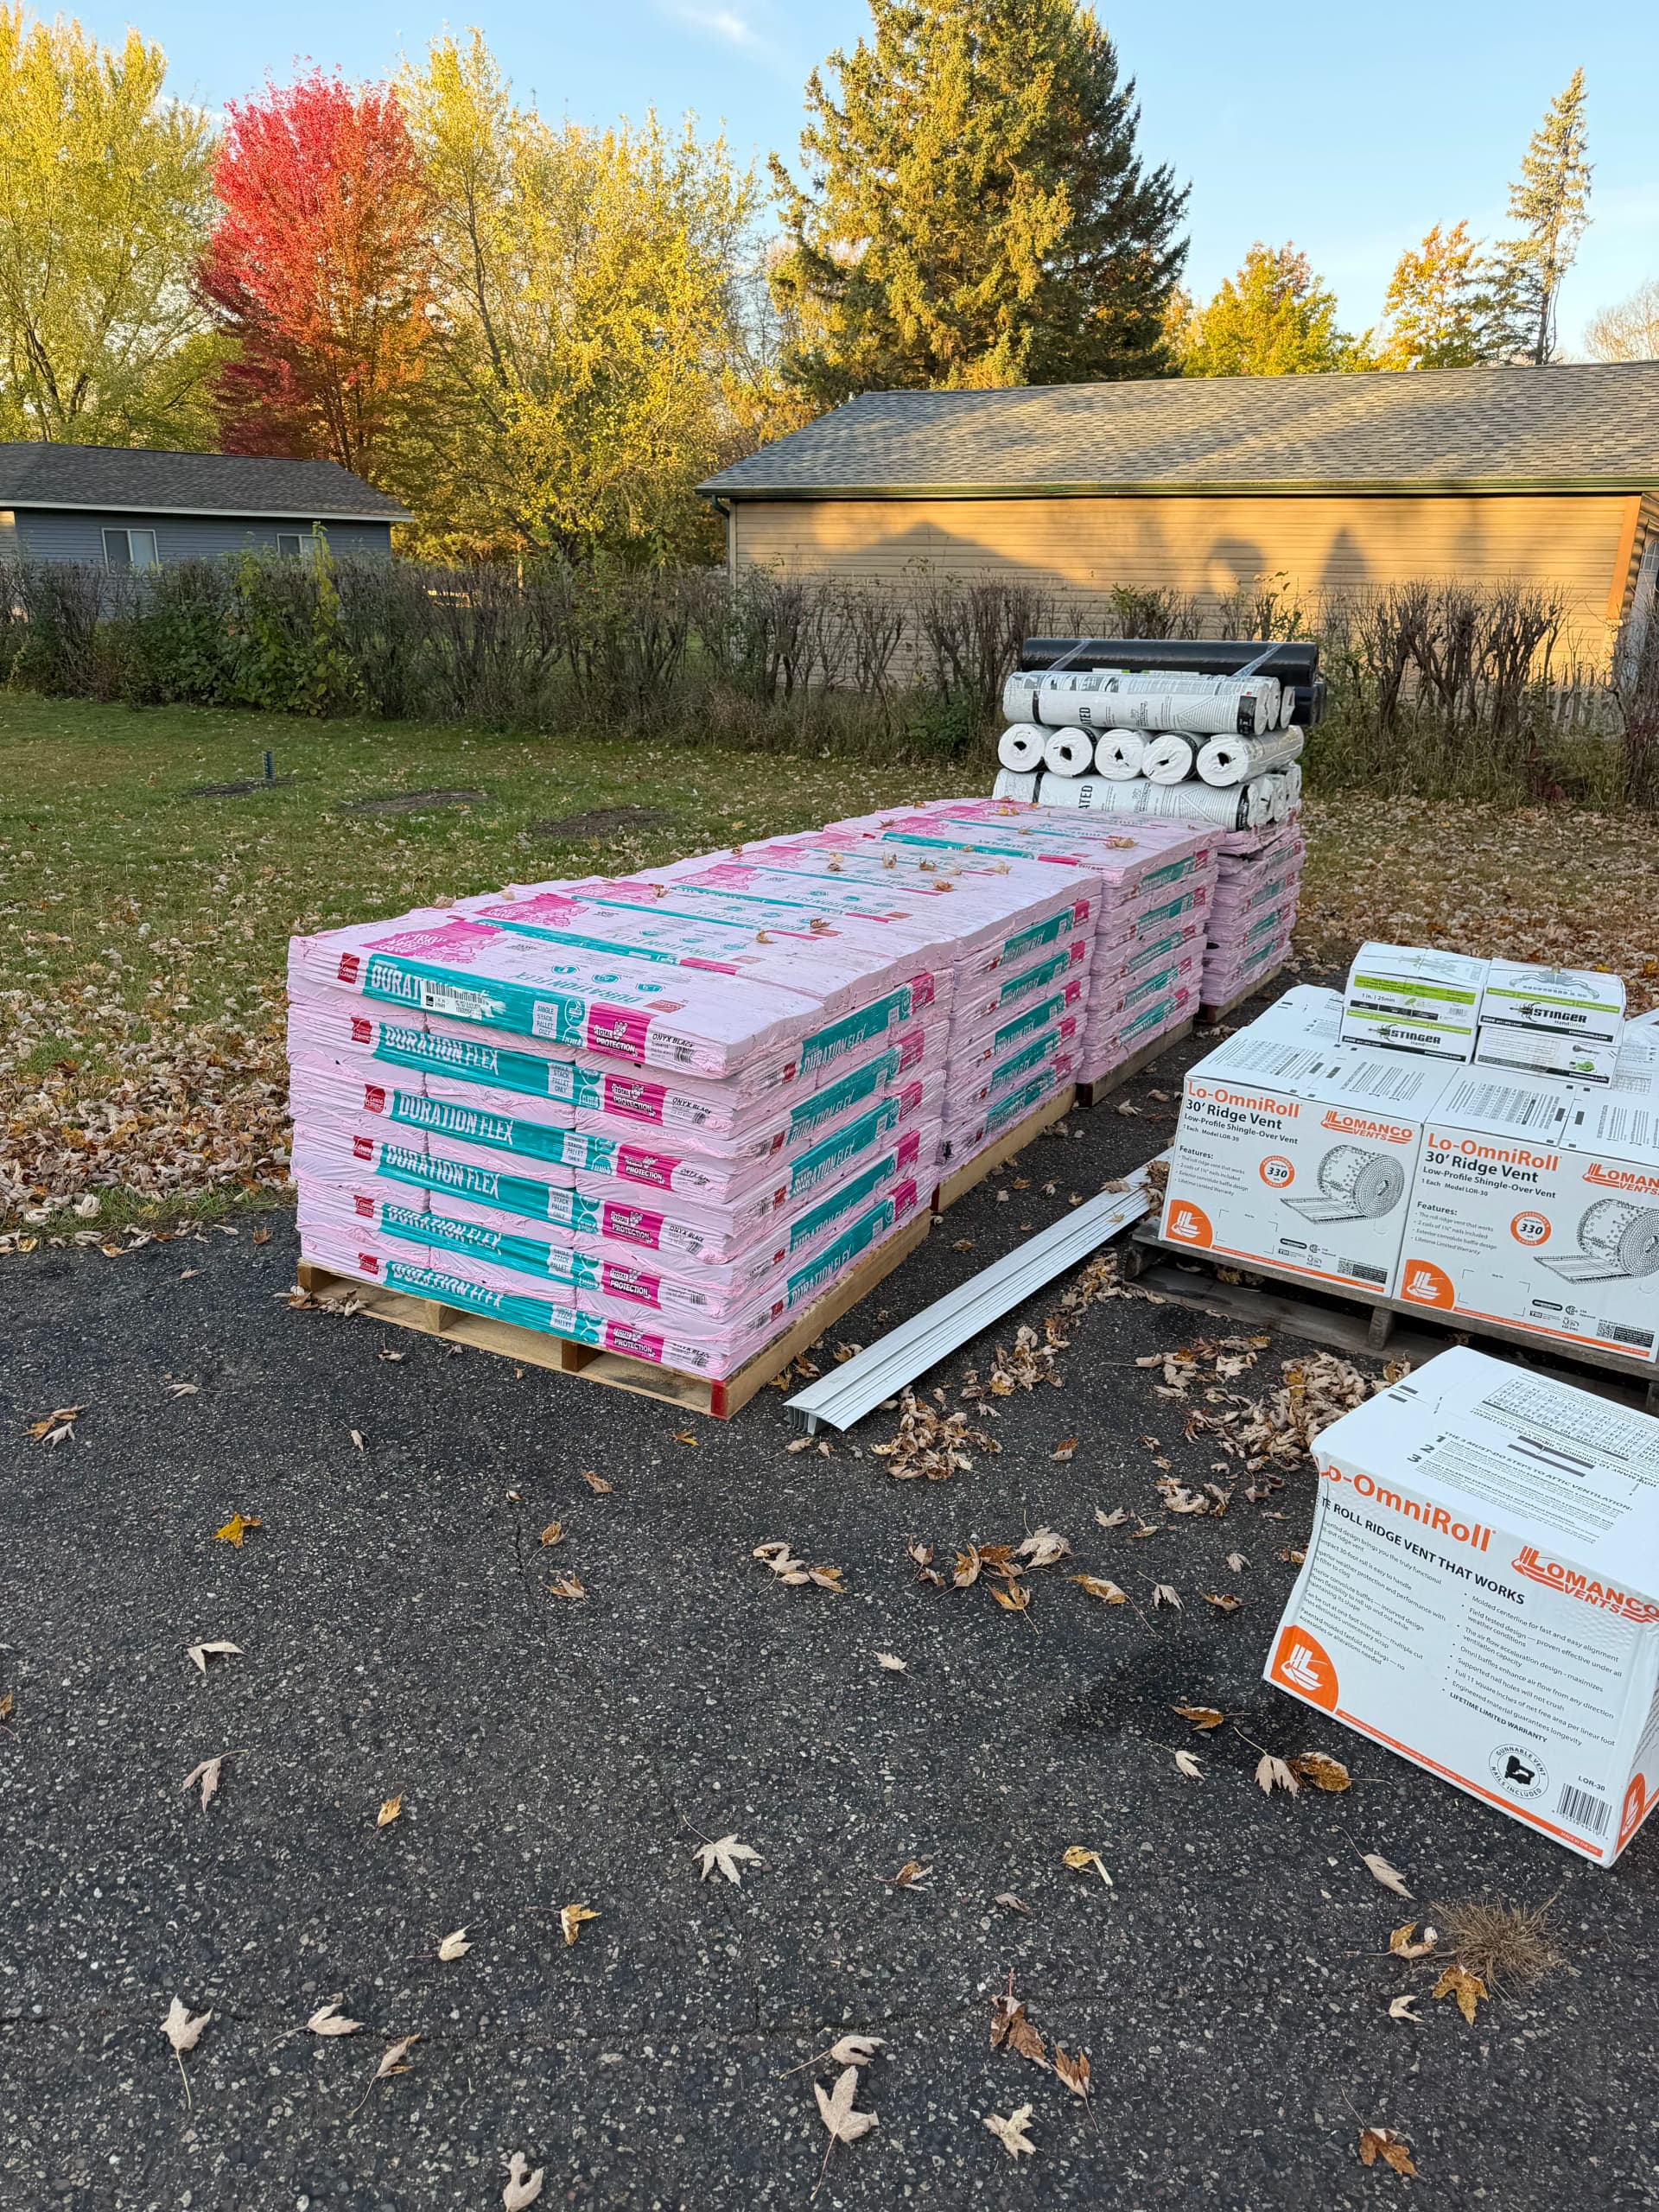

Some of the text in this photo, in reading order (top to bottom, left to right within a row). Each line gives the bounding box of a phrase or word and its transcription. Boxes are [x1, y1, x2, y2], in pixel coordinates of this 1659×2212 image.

[537, 1014, 553, 1022] STACK
[1534, 1007, 1587, 1024] STINGER
[595, 1037, 636, 1053] PROTECTION
[596, 1027, 613, 1037] TOTAL
[652, 1033, 671, 1044] ONYX
[1391, 1029, 1441, 1045] STINGER
[385, 1026, 499, 1076] DURATION FLEX
[804, 1039, 847, 1074] DURATION
[613, 1085, 630, 1096] TOTAL
[672, 1096, 691, 1109] ONYX
[1187, 1082, 1300, 1118] Lo-OmniRoll
[398, 1094, 513, 1146] DURATION FLEX
[1184, 1113, 1298, 1144] Low-Profile Shingle-Over Vent
[1206, 1103, 1248, 1124] Ridge
[1249, 1113, 1282, 1129] Vent
[1325, 1110, 1413, 1139] LOMANCO
[1201, 1128, 1218, 1137] Model
[1351, 1128, 1387, 1141] VENTS
[1179, 1145, 1213, 1159] Features:
[1427, 1130, 1558, 1173] Lo-OmniRoll
[387, 1145, 499, 1200] DURATION FLEX
[626, 1166, 663, 1181] PROTECTION
[1267, 1166, 1287, 1179] 330
[1422, 1166, 1555, 1198] Low-Profile Shingle-Over Vent
[1451, 1154, 1497, 1178] Ridge
[1500, 1165, 1538, 1184] Vent
[1444, 1182, 1464, 1192] Model
[1465, 1186, 1488, 1196] LOR-30
[1619, 1182, 1659, 1196] VENTS
[613, 1212, 629, 1224] TOTAL
[1416, 1200, 1457, 1216] Features:
[388, 1206, 465, 1243] DURATION
[612, 1224, 652, 1240] PROTECTION
[669, 1225, 689, 1236] ONYX
[1520, 1222, 1542, 1236] 330
[610, 1280, 649, 1296] PROTECTION
[613, 1338, 653, 1354] PROTECTION
[1419, 1443, 1436, 1453] 2
[1433, 1434, 1446, 1443] 1
[1406, 1452, 1422, 1463] 3
[1443, 1431, 1460, 1440] THE
[1465, 1440, 1506, 1459] MUST-DO
[1505, 1457, 1533, 1470] STEPS
[1544, 1473, 1571, 1485] ATTIC
[1570, 1484, 1634, 1511] VENTILATION!
[1333, 1503, 1525, 1606] ROLL RIDGE VENT THAT WORKS
[1521, 1545, 1659, 1619] LOMANCO
[1564, 1584, 1621, 1614] VENTS
[1467, 1615, 1526, 1647] weather conditions
[1469, 1607, 1622, 1678] Field tested design proven effective under all
[1471, 1595, 1618, 1664] Molded centerline for fast and easy alignment
[1463, 1634, 1522, 1669] ventilation capacity
[1465, 1626, 1603, 1693] The air flow acceleration design maximizes
[1457, 1656, 1564, 1712] Supported nail holes will not crush
[1460, 1645, 1614, 1719] Omni baffles enhance air flow from any direction
[1449, 1691, 1547, 1743] LIFETIME LIMITED WARRANTY
[1452, 1681, 1582, 1747] Engineered material guarantees longevity
[1454, 1669, 1466, 1679] Full
[1474, 1680, 1496, 1695] square
[1496, 1689, 1516, 1704] inches
[1525, 1703, 1537, 1713] net
[1537, 1708, 1551, 1719] free
[1551, 1716, 1567, 1726] area
[1567, 1723, 1579, 1732] per
[1580, 1727, 1599, 1740] linear
[1600, 1736, 1614, 1746] foot
[1496, 1745, 1546, 1776] GUNNABLE VENT
[1491, 1766, 1542, 1797] NAILS INCLUDED
[1578, 1774, 1605, 1793] LOR-30
